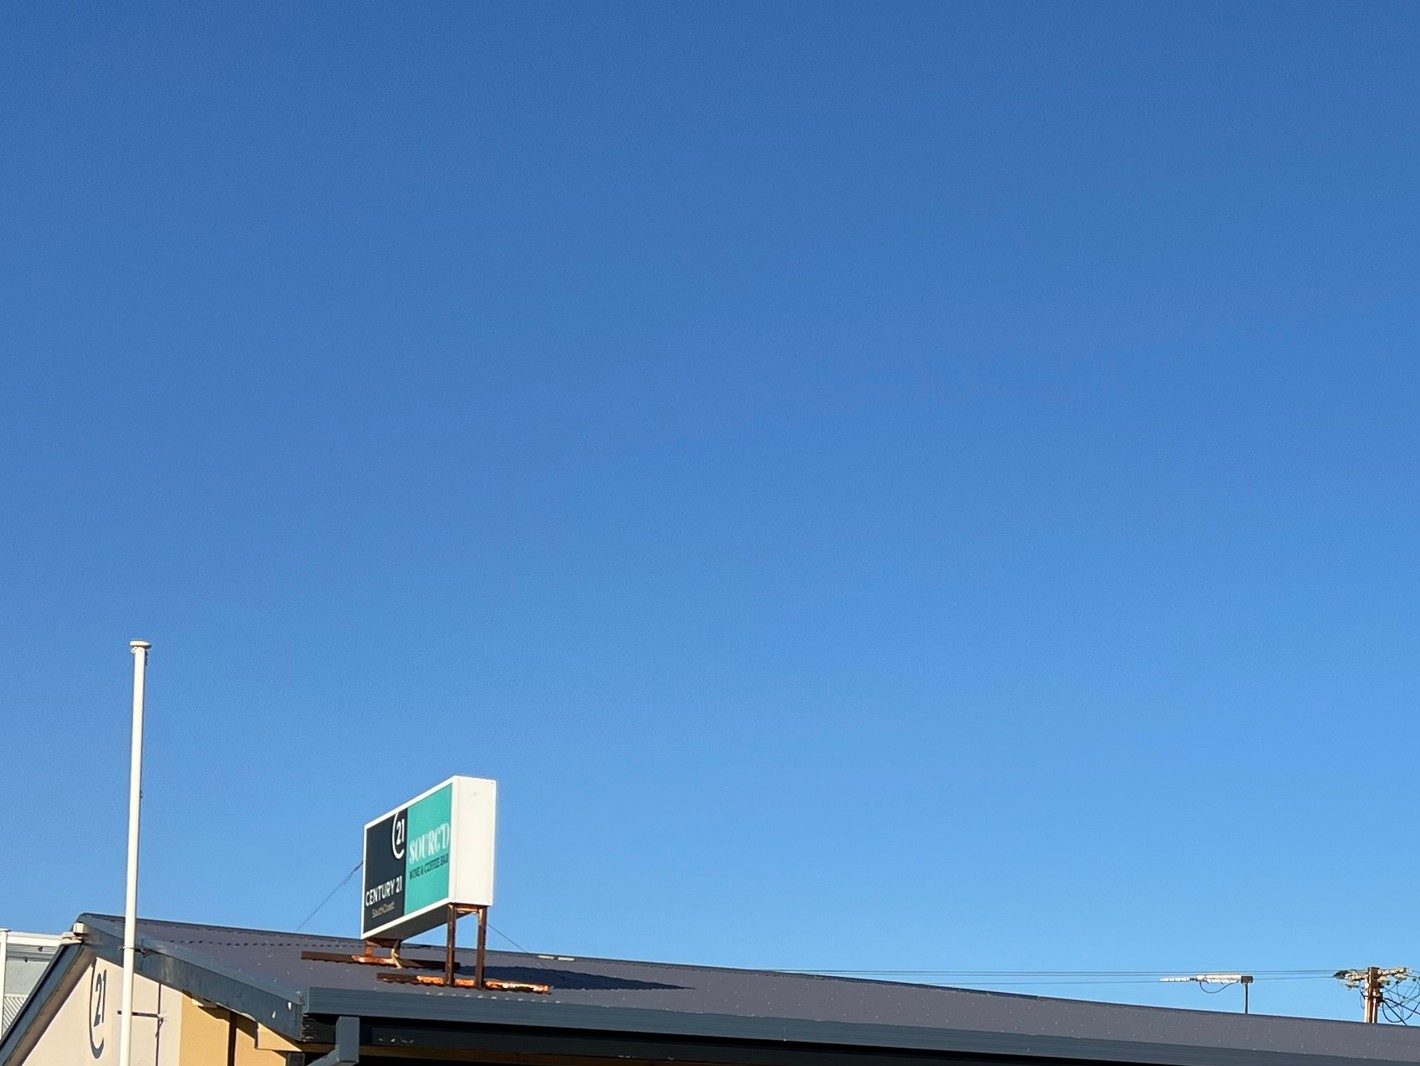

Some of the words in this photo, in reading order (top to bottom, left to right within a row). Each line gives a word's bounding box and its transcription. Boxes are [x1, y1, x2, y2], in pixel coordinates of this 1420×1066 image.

[409, 822, 450, 864] SOURC'D
[366, 878, 395, 907] CENTURY
[396, 875, 402, 894] 21
